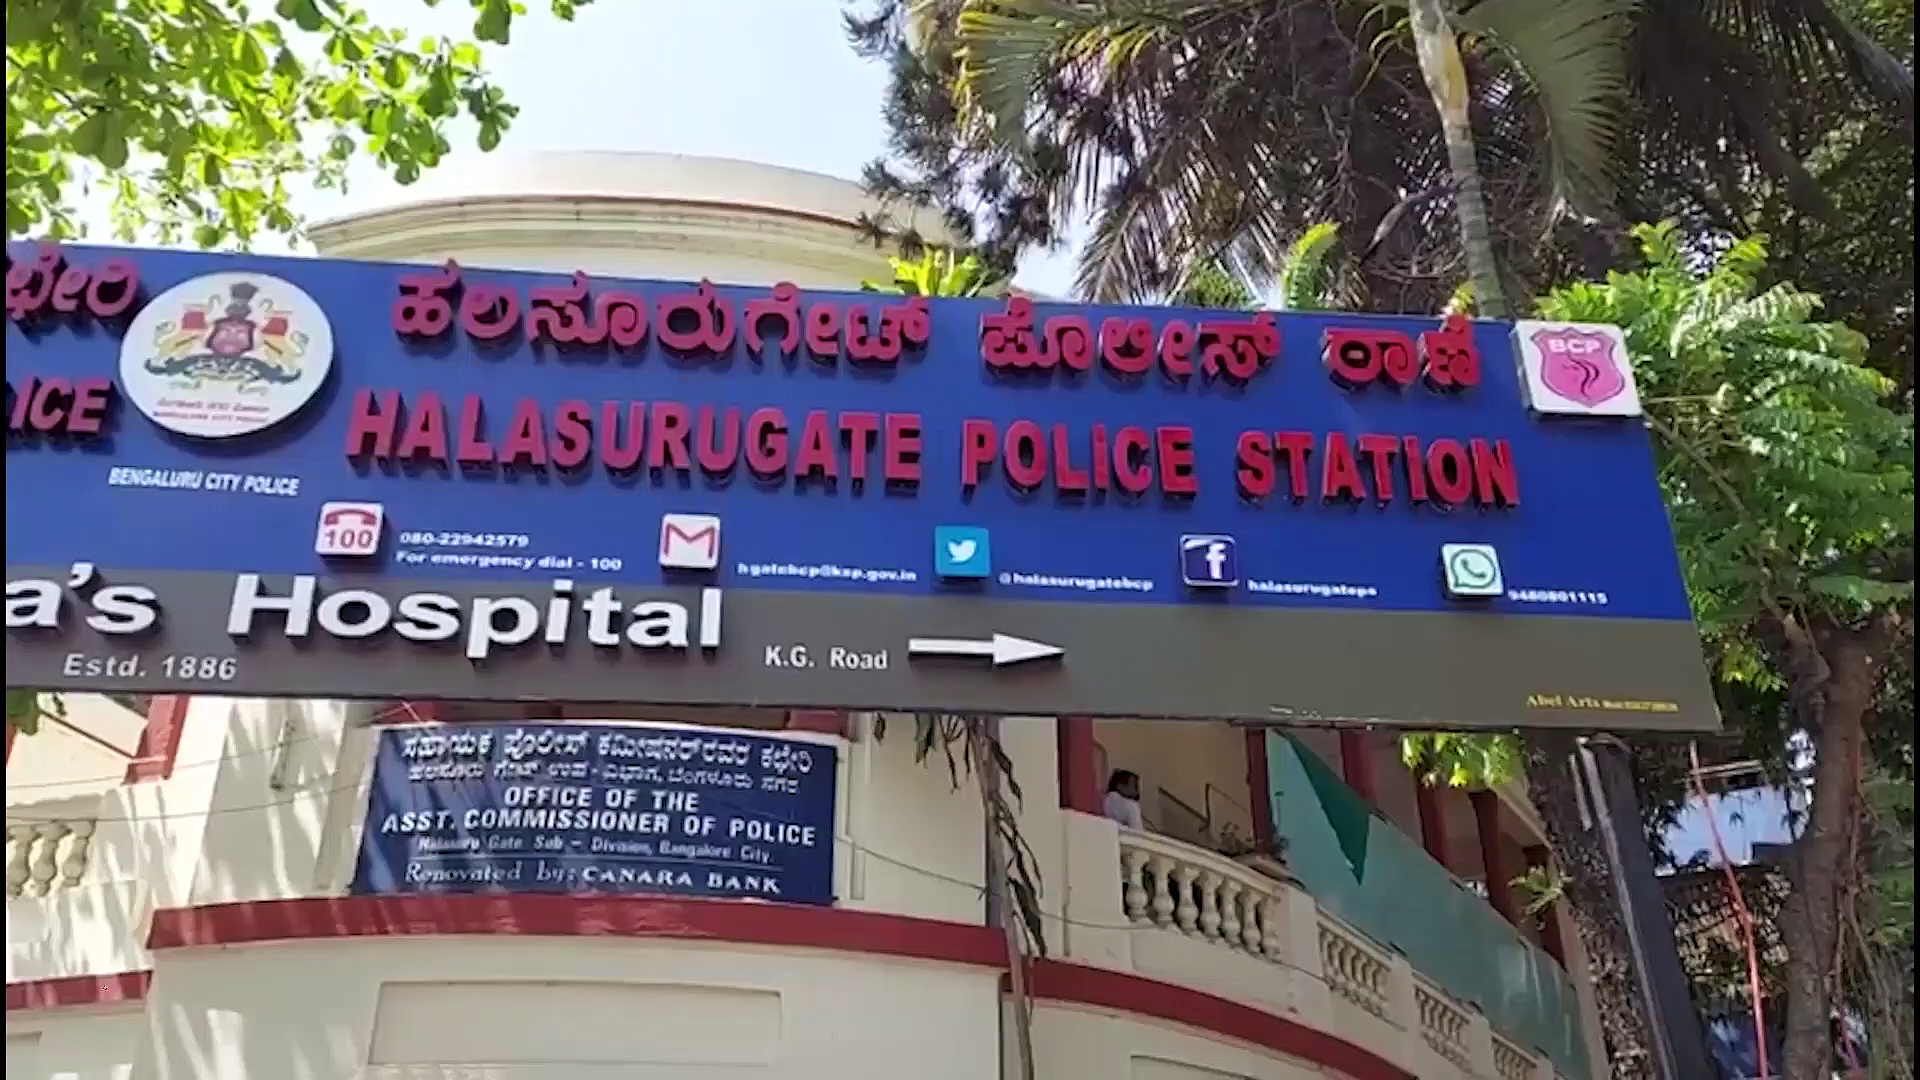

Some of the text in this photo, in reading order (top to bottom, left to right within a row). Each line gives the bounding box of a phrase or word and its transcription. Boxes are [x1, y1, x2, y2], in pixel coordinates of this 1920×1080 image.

[392, 258, 931, 362] ಹಲಸೂರುಗೇಟ್
[980, 295, 1281, 380] ಪೊಲೀಸ್
[1549, 338, 1600, 355] BCP
[347, 388, 1519, 506] HALASURUGATE POLICE STATION
[108, 466, 300, 497] BENGALURU CITY POLICE
[325, 528, 372, 549] 100
[399, 531, 530, 549] 080-22942579
[396, 550, 427, 564] For
[430, 553, 533, 571] emergency
[538, 555, 573, 569] dial
[591, 556, 622, 572] 100
[227, 573, 723, 660] Hospital
[64, 653, 239, 680] Estd. 1886
[764, 644, 889, 670] K.G. Road
[504, 786, 700, 813] OFFICE OF THE
[381, 807, 816, 847] ASST. COMMISSIONER OF POLICE
[488, 834, 523, 850] Gate
[533, 834, 564, 850] Sub
[659, 839, 731, 859] Bangalore
[404, 860, 523, 884] Renovated
[581, 865, 693, 887] CANARA
[706, 871, 782, 895] BANK
